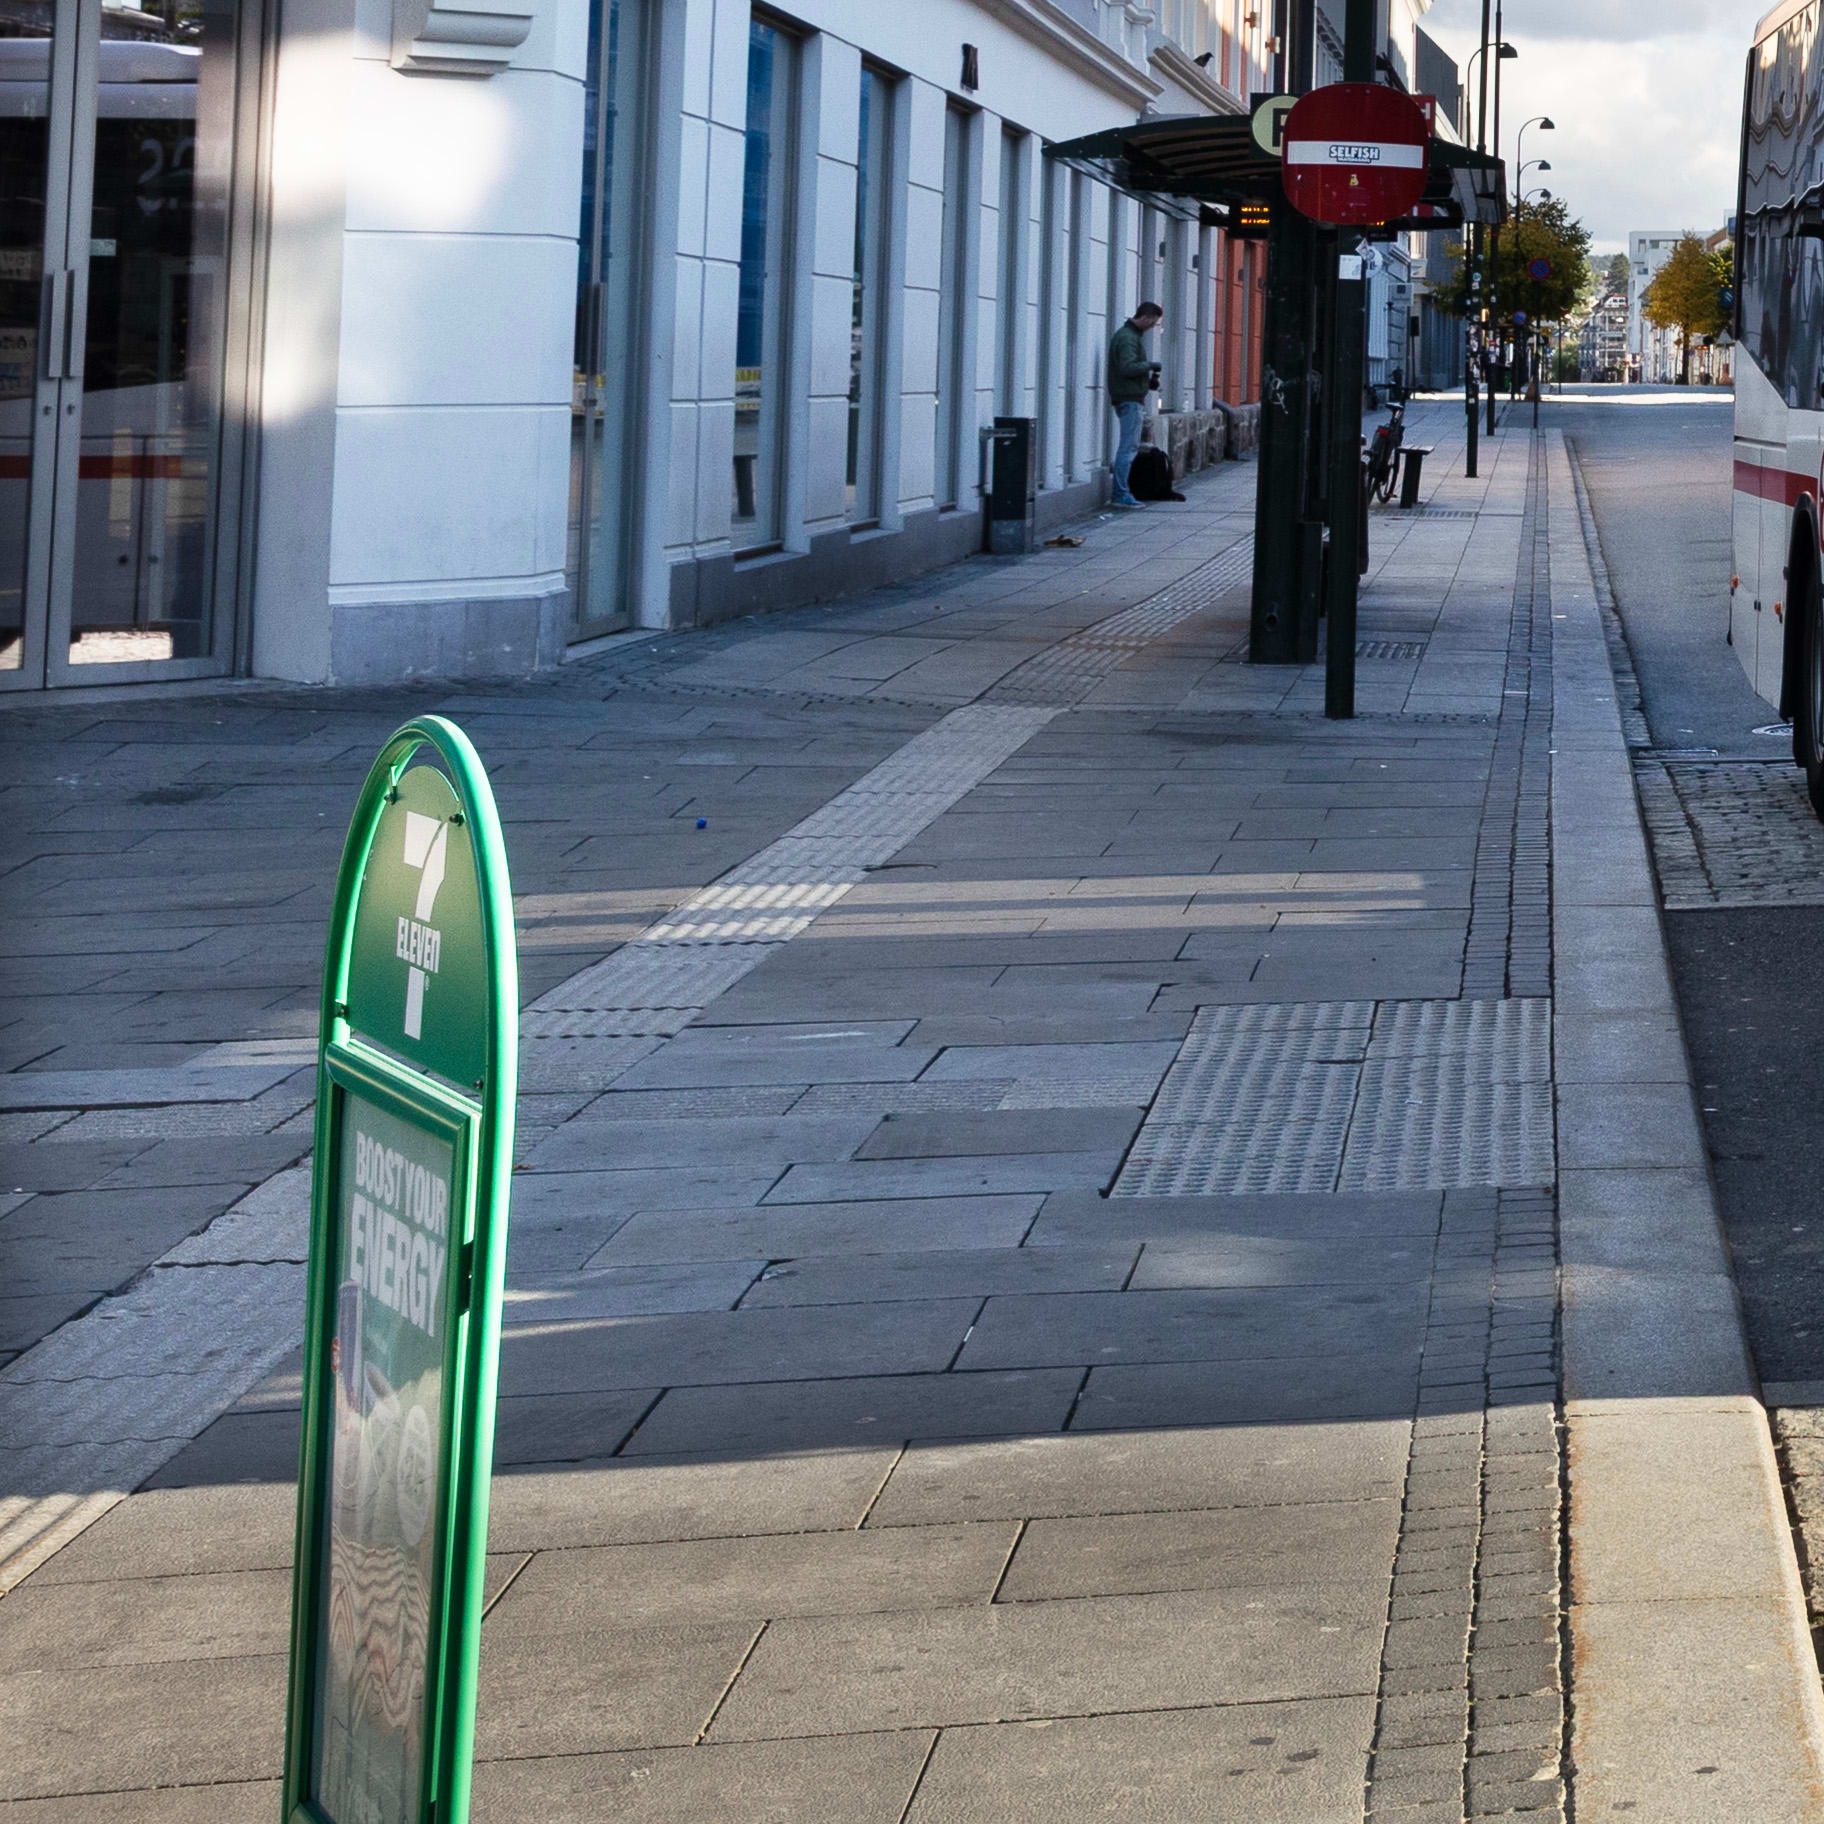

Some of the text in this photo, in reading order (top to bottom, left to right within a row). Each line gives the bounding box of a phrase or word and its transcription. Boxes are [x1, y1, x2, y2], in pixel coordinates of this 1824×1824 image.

[1330, 145, 1379, 160] SELFISH
[355, 1130, 448, 1239] BOOST YOUR
[350, 1192, 446, 1338] ENERGY
